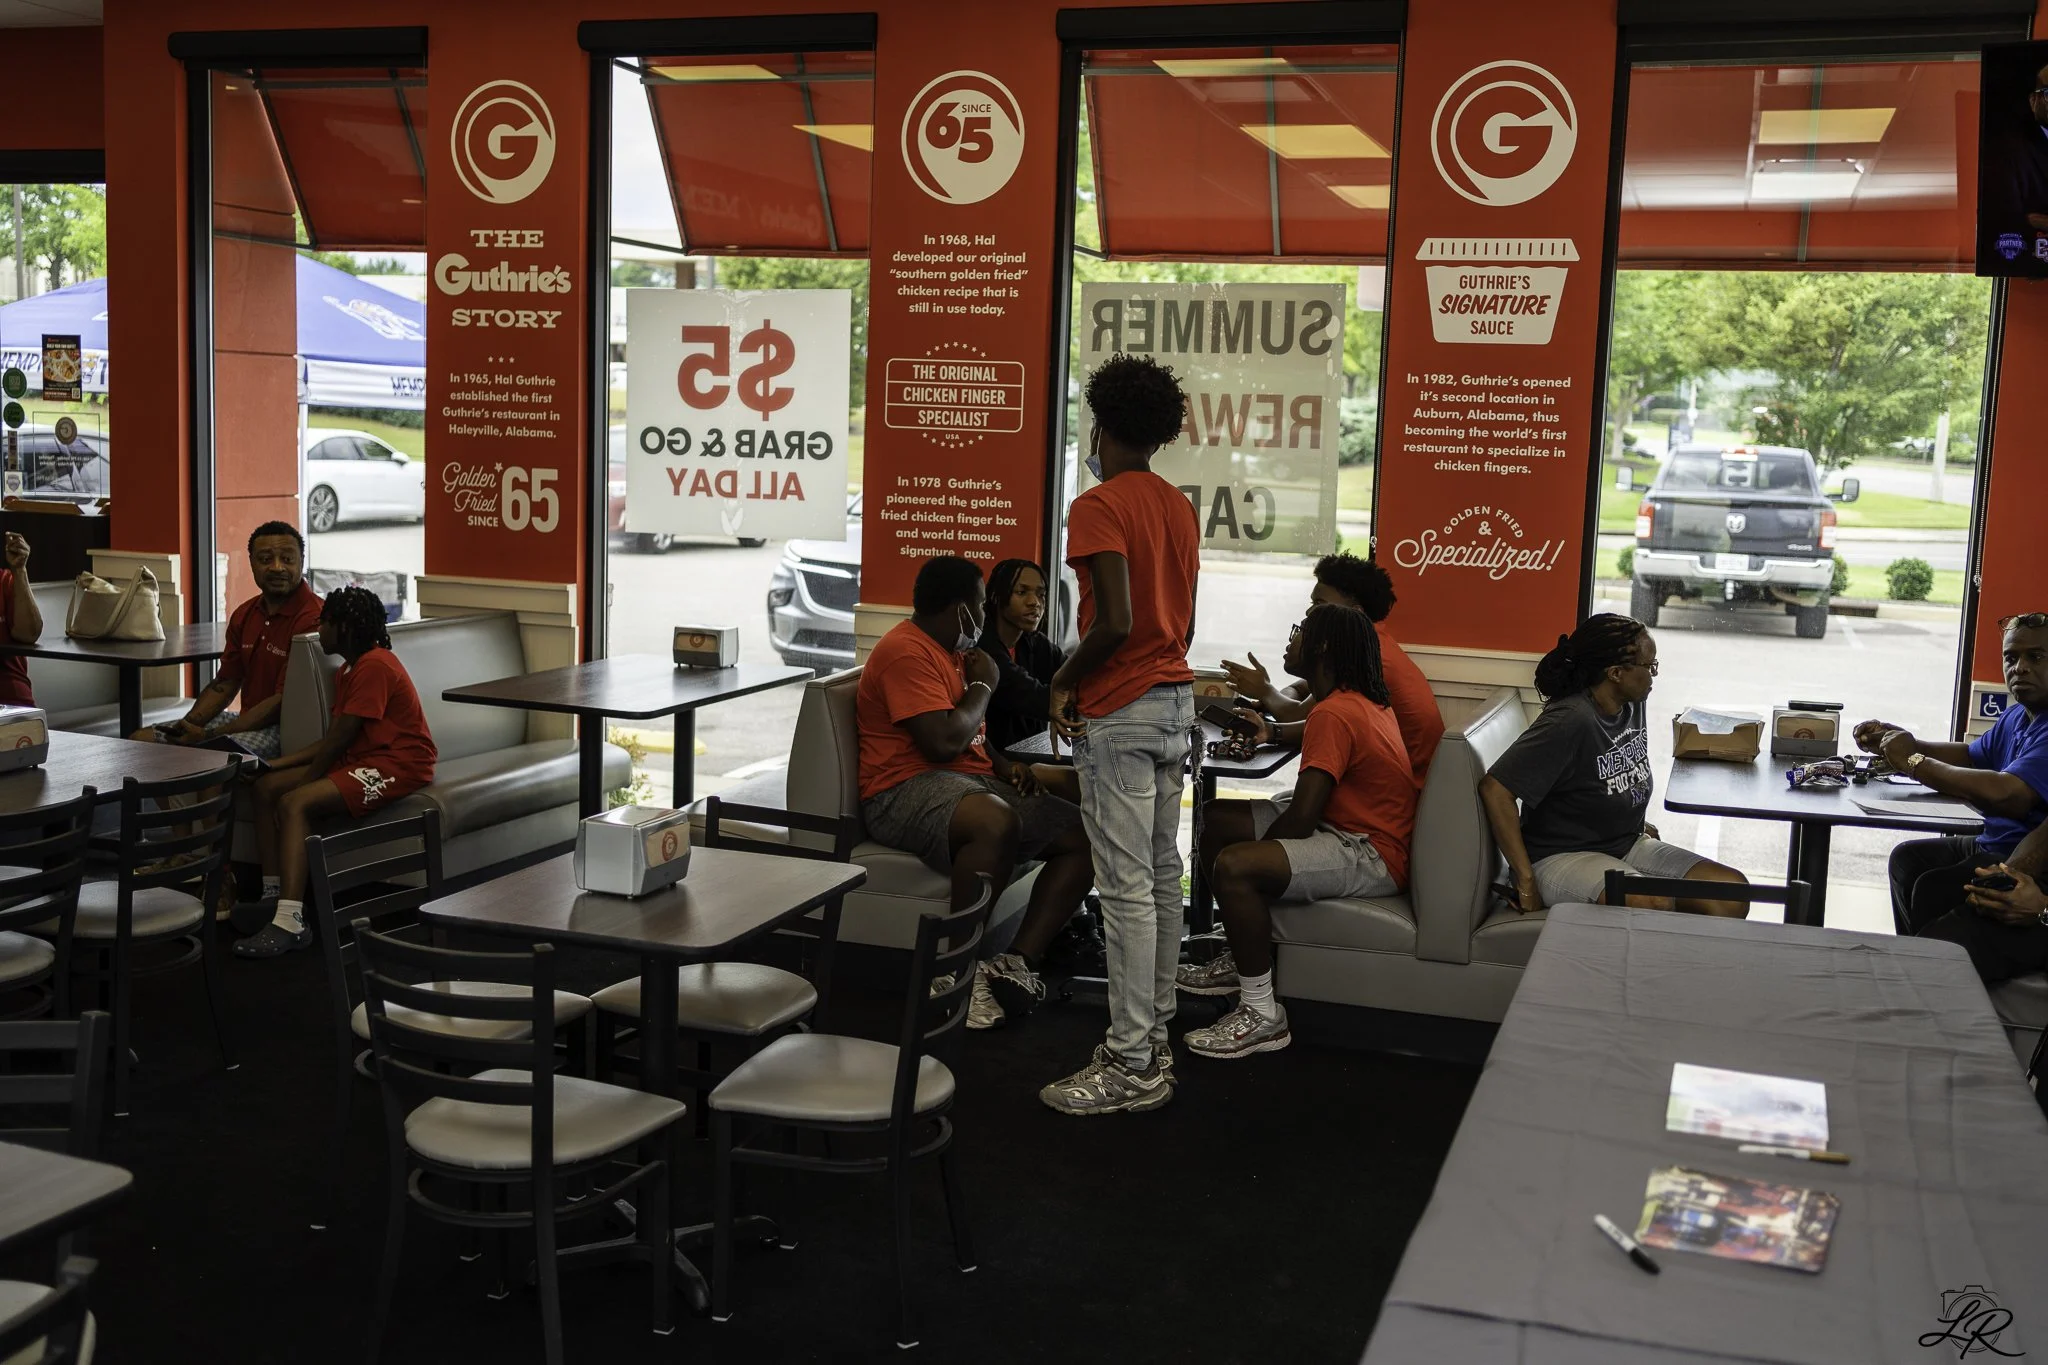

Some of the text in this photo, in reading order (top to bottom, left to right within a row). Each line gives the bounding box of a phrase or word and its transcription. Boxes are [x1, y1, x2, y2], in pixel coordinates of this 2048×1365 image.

[962, 104, 991, 113] SINCE
[925, 102, 994, 164] 65
[470, 230, 544, 248] THE
[924, 235, 995, 247] In 1968, Hal
[892, 251, 953, 264] developed
[980, 252, 1026, 265] original
[434, 253, 571, 295] Guthrie's
[890, 268, 1028, 282] "southern golden fried"
[1459, 275, 1530, 290] GUTHRIE'S
[897, 285, 1019, 299] chicken recipe that is
[909, 302, 1005, 317] still in use today.
[1438, 294, 1551, 315] SIGNATURE
[452, 308, 562, 328] STORY
[1470, 320, 1514, 335] SAUCE
[450, 373, 556, 386] In 1965, Hal Guthrie
[912, 364, 998, 381] THE ORIGINAL
[1407, 373, 1571, 389] In 1982, Guthrie's opened
[450, 390, 552, 403] established the first
[903, 387, 1006, 405] CHICKEN FINGER
[1420, 390, 1555, 405] it's second location in
[442, 407, 560, 421] Guthrie's restaurant in
[918, 410, 989, 427] SPECIALIST
[1413, 408, 1559, 423] Auburn, Alabama, thus
[449, 424, 556, 438] Haleyville, Alabama.
[1405, 424, 1567, 440] becoming the world's first
[1403, 443, 1565, 457] restaurant to specialize in
[1434, 459, 1531, 475] chicken fingers.
[442, 462, 497, 493] Golden
[898, 476, 1002, 490] In 1978 Guthrie's
[454, 489, 498, 512] Fried
[502, 466, 559, 533] 65
[887, 493, 1012, 509] pioneered the golden
[468, 515, 498, 527] SINCE
[880, 509, 1017, 527] fried chicken finger box
[1444, 506, 1523, 538] GOLDEN FRIED
[896, 528, 1000, 542] and world famous
[1478, 521, 1492, 535] &
[900, 545, 955, 558] signature
[1394, 529, 1565, 580] Specialized!
